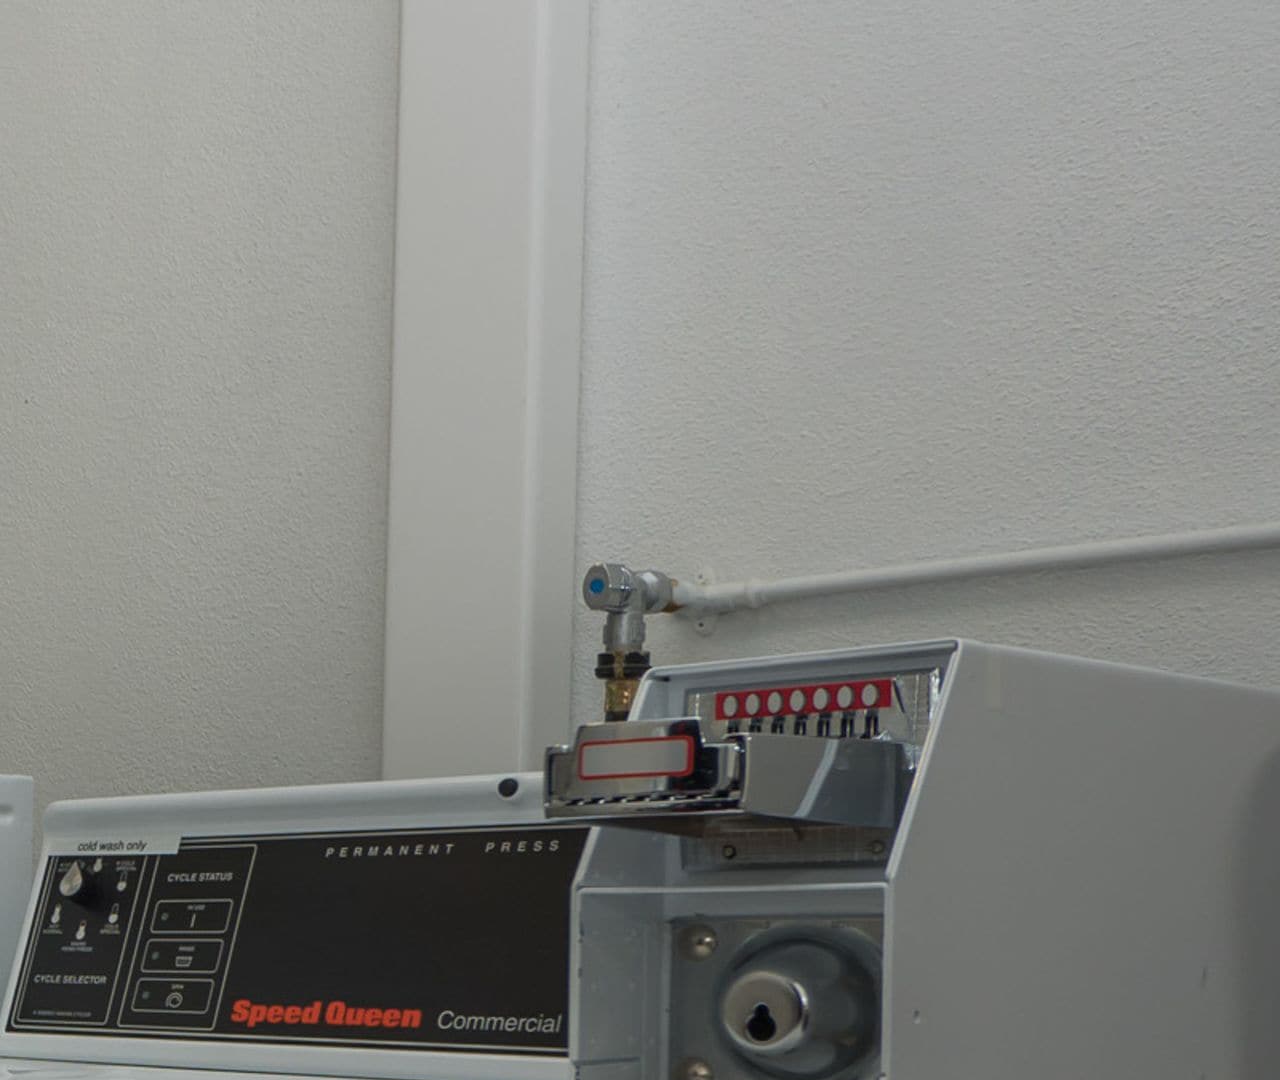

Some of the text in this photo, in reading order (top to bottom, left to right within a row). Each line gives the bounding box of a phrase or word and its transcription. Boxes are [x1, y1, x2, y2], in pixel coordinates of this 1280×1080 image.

[77, 840, 147, 852] cold wash only
[325, 839, 560, 858] PERMANENT PRESS
[167, 872, 233, 883] CYCLE STATUS
[33, 974, 107, 985] CYCLE SELECTOR
[231, 998, 423, 1029] Speed Queen
[437, 1010, 562, 1034] Commercial
